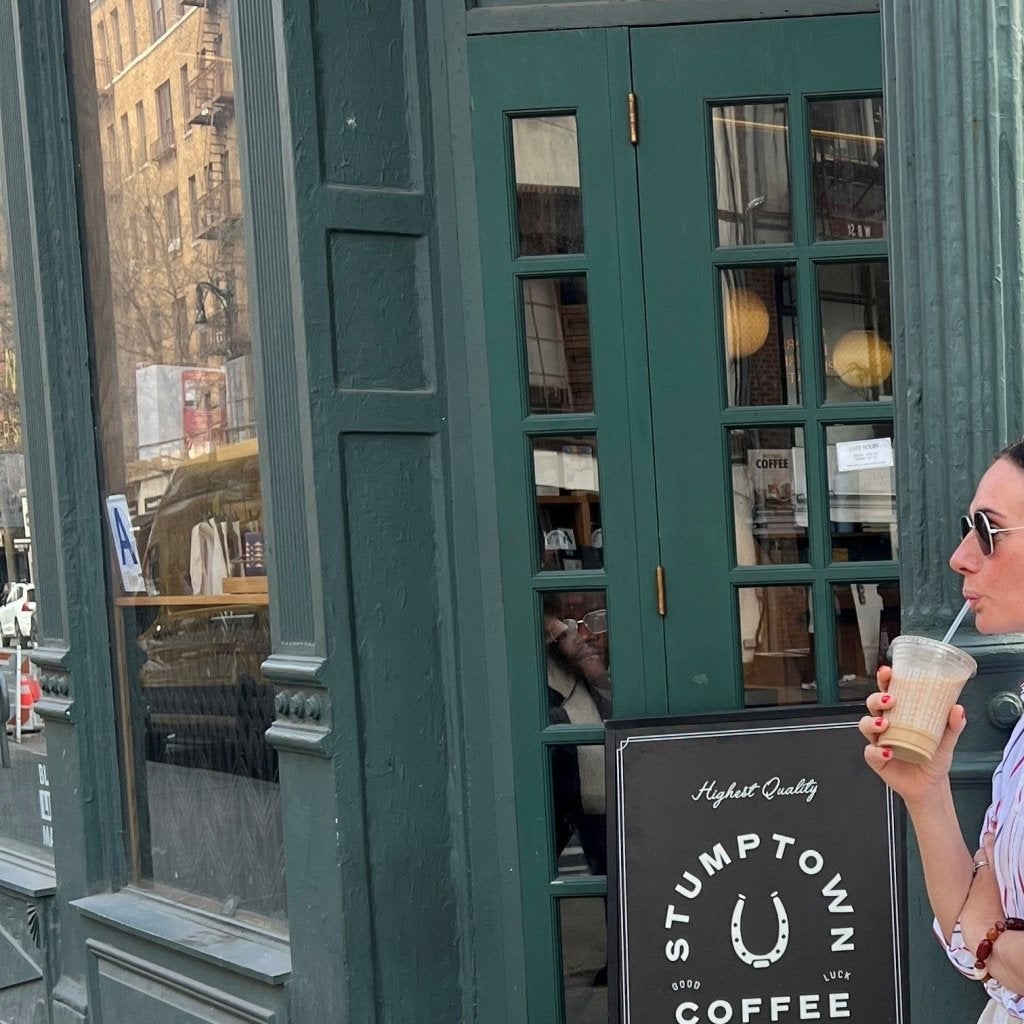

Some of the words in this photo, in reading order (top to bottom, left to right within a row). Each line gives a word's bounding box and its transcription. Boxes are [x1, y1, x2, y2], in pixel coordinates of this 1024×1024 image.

[755, 458, 789, 470] COFFEE
[113, 507, 139, 566] A
[691, 780, 759, 808] Highest
[762, 776, 819, 802] Quality
[665, 833, 855, 962] STUMPTOWN
[671, 979, 701, 991] GOOD
[822, 969, 852, 982] LUCK
